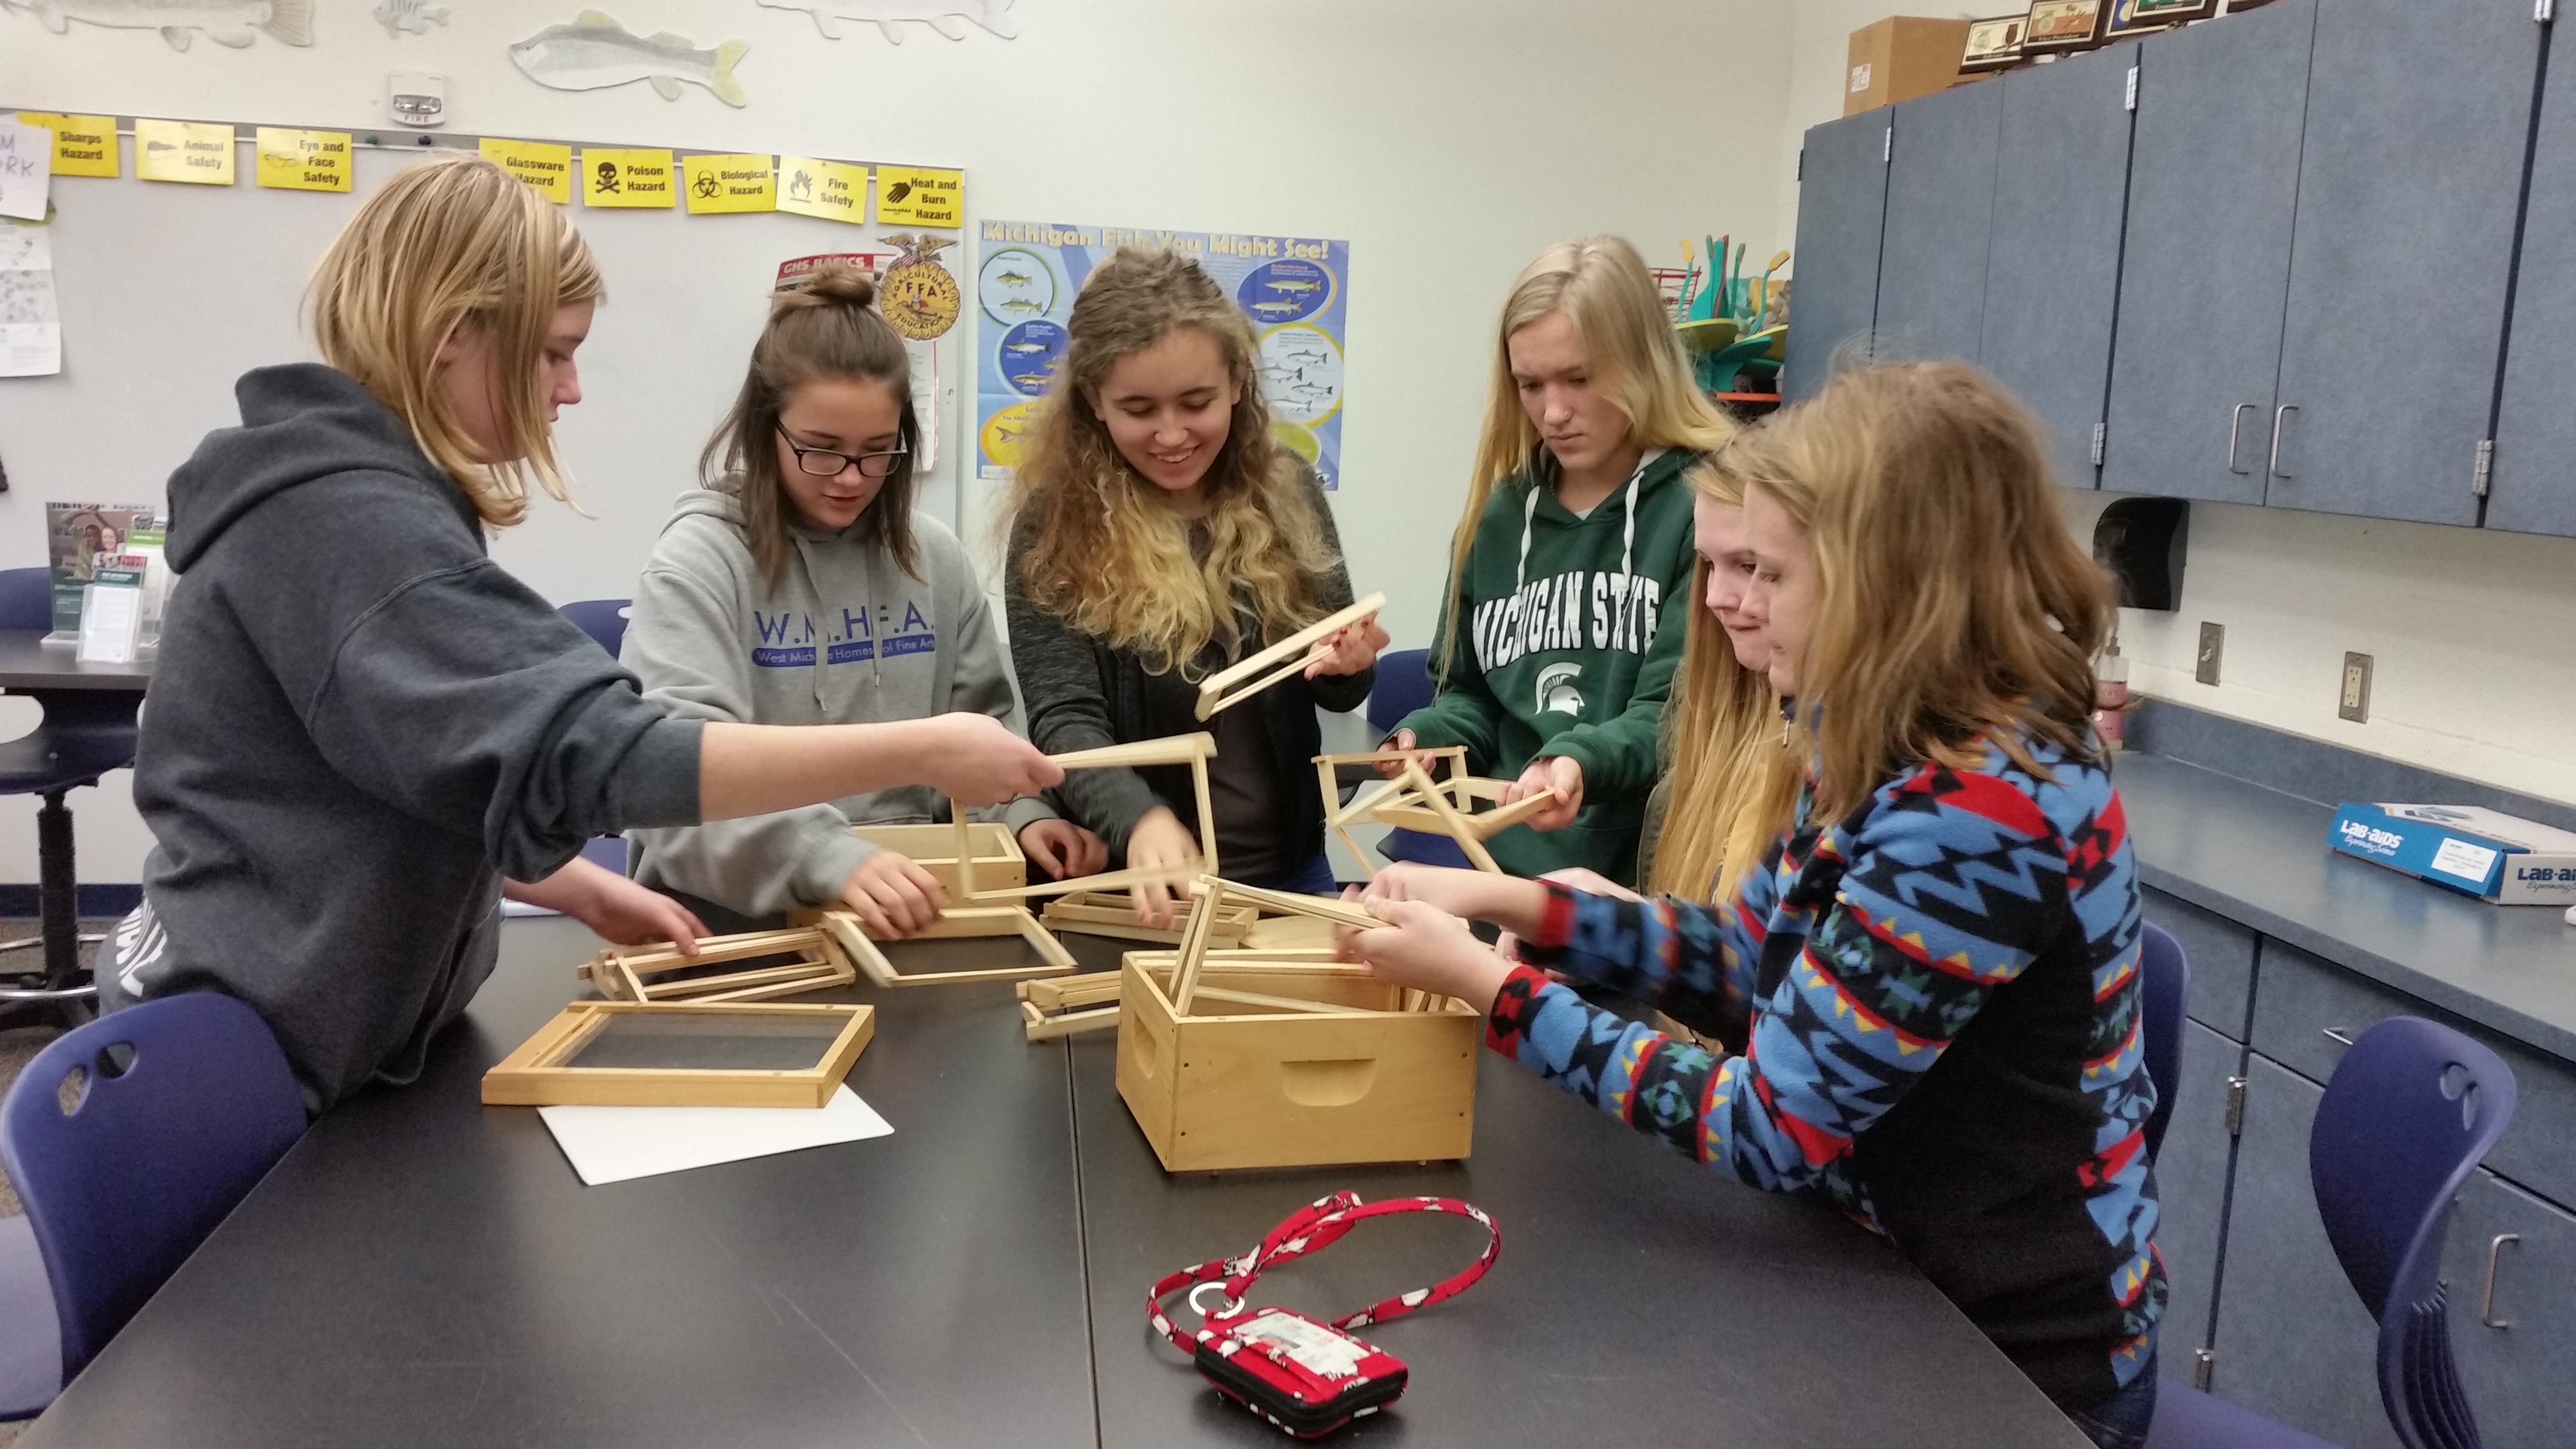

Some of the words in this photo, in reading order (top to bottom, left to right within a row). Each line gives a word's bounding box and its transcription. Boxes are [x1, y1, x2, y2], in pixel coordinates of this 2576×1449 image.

[404, 114, 430, 123] FIRE
[60, 131, 102, 145] Sharps
[184, 140, 224, 151] Animal
[300, 140, 319, 151] Eye
[323, 142, 344, 152] and
[61, 148, 102, 160] Hazard
[186, 156, 222, 169] Safety
[308, 157, 335, 167] Face
[506, 156, 564, 172] Glassware
[627, 166, 663, 176] Poison
[721, 170, 768, 180] Biological
[304, 172, 339, 185] Safety
[828, 178, 848, 190] Fire
[911, 177, 935, 189] Heat
[938, 180, 957, 190] and
[628, 181, 665, 191] Hazard
[729, 185, 763, 195] Hazard
[821, 193, 853, 208] Safety
[921, 194, 946, 205] Burn
[916, 209, 951, 221] Hazard
[982, 222, 1094, 248] Michigan
[1101, 227, 1149, 247] Fish
[1156, 230, 1202, 252] You
[1208, 234, 1278, 258] Might
[1284, 237, 1330, 259] See!
[783, 259, 809, 274] GHS
[906, 282, 937, 297] FFA
[1472, 571, 1583, 675] MICHIGAN
[757, 651, 786, 663] West
[835, 642, 893, 659] Homesol
[895, 640, 917, 651] Fine
